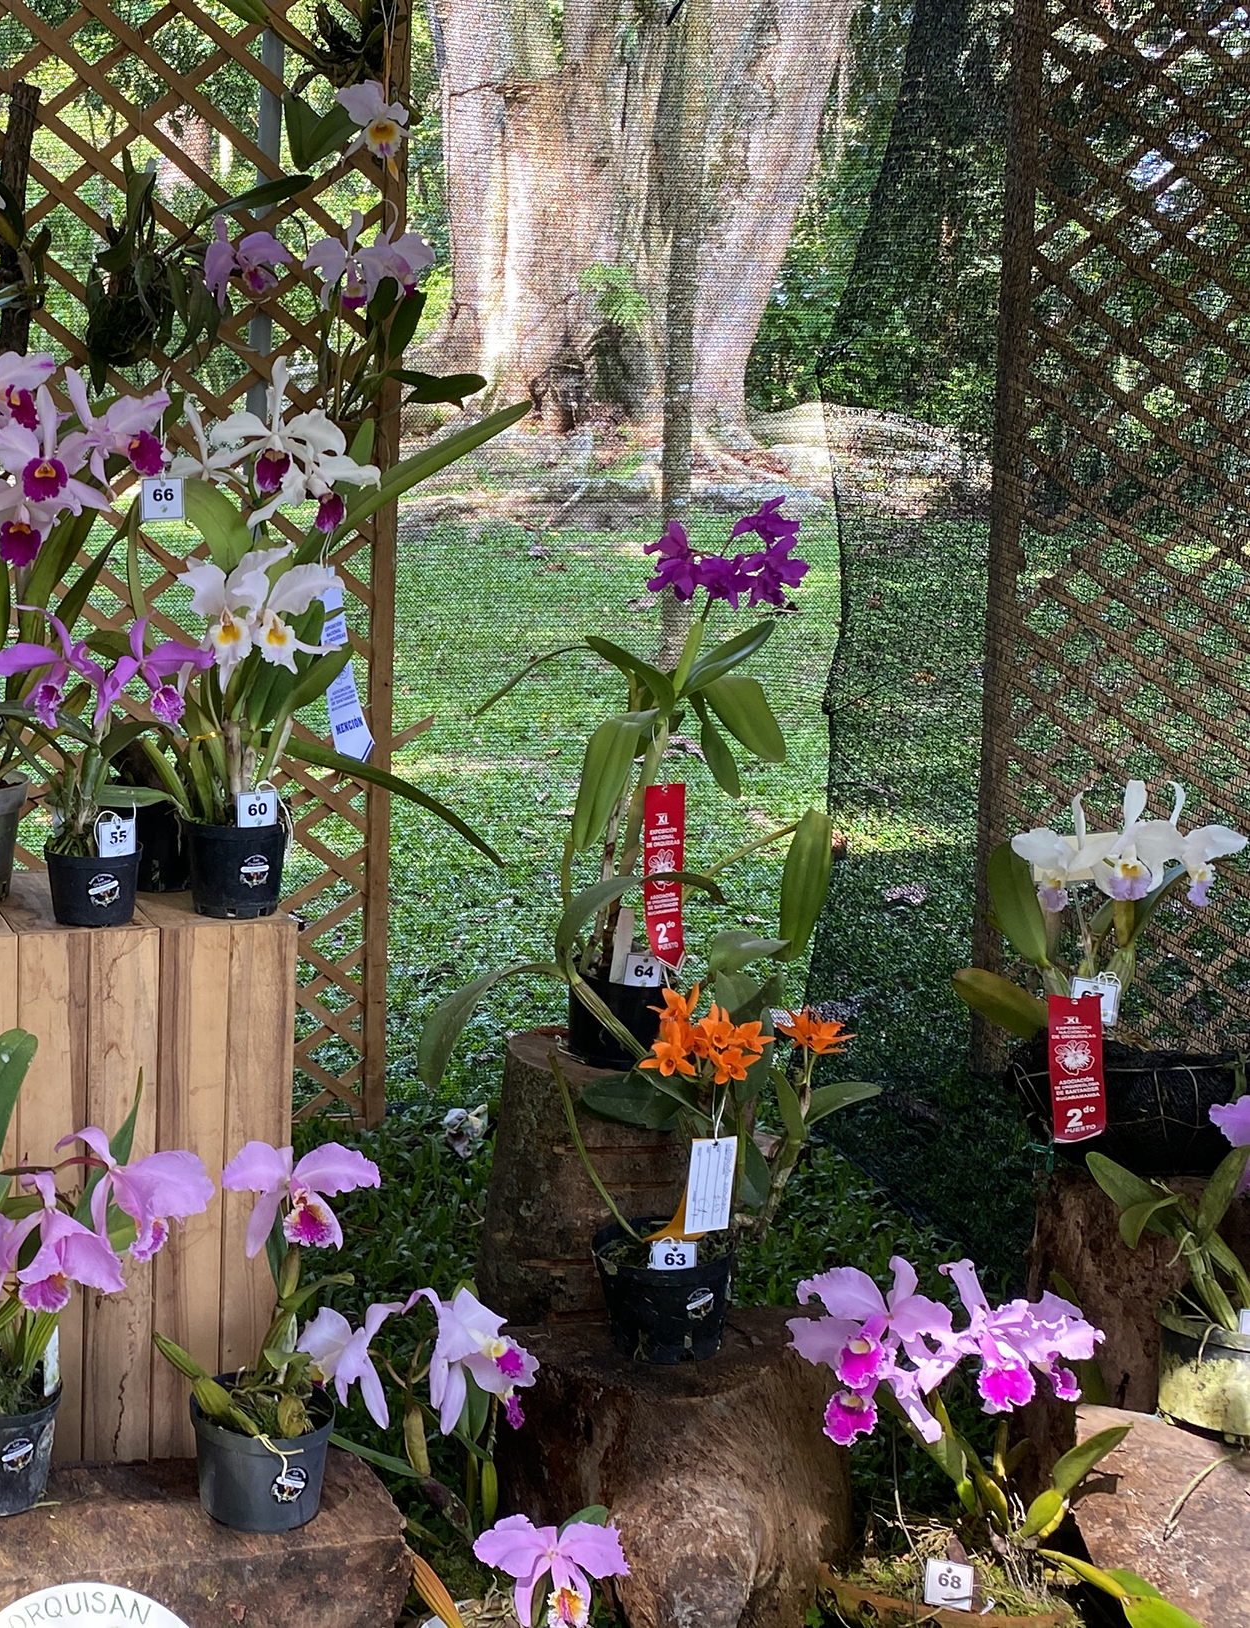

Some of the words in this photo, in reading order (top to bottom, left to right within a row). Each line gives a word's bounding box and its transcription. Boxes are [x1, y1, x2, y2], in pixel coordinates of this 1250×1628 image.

[153, 488, 174, 502] 66
[336, 715, 364, 735] MENCIÓN
[248, 802, 268, 816] 60
[658, 815, 668, 825] XI
[110, 830, 127, 844] 55
[658, 941, 679, 951] PUESTO
[634, 965, 654, 978] 64
[1059, 1076, 1094, 1085] ASOCIACIÓN
[1065, 1086, 1099, 1095] SANTANDER
[1066, 1105, 1096, 1128] 2do
[1064, 1124, 1096, 1134] PUESTO
[664, 1253, 686, 1266] 63
[938, 1573, 962, 1590] 68
[8, 1591, 152, 1628] ORQUISAN
